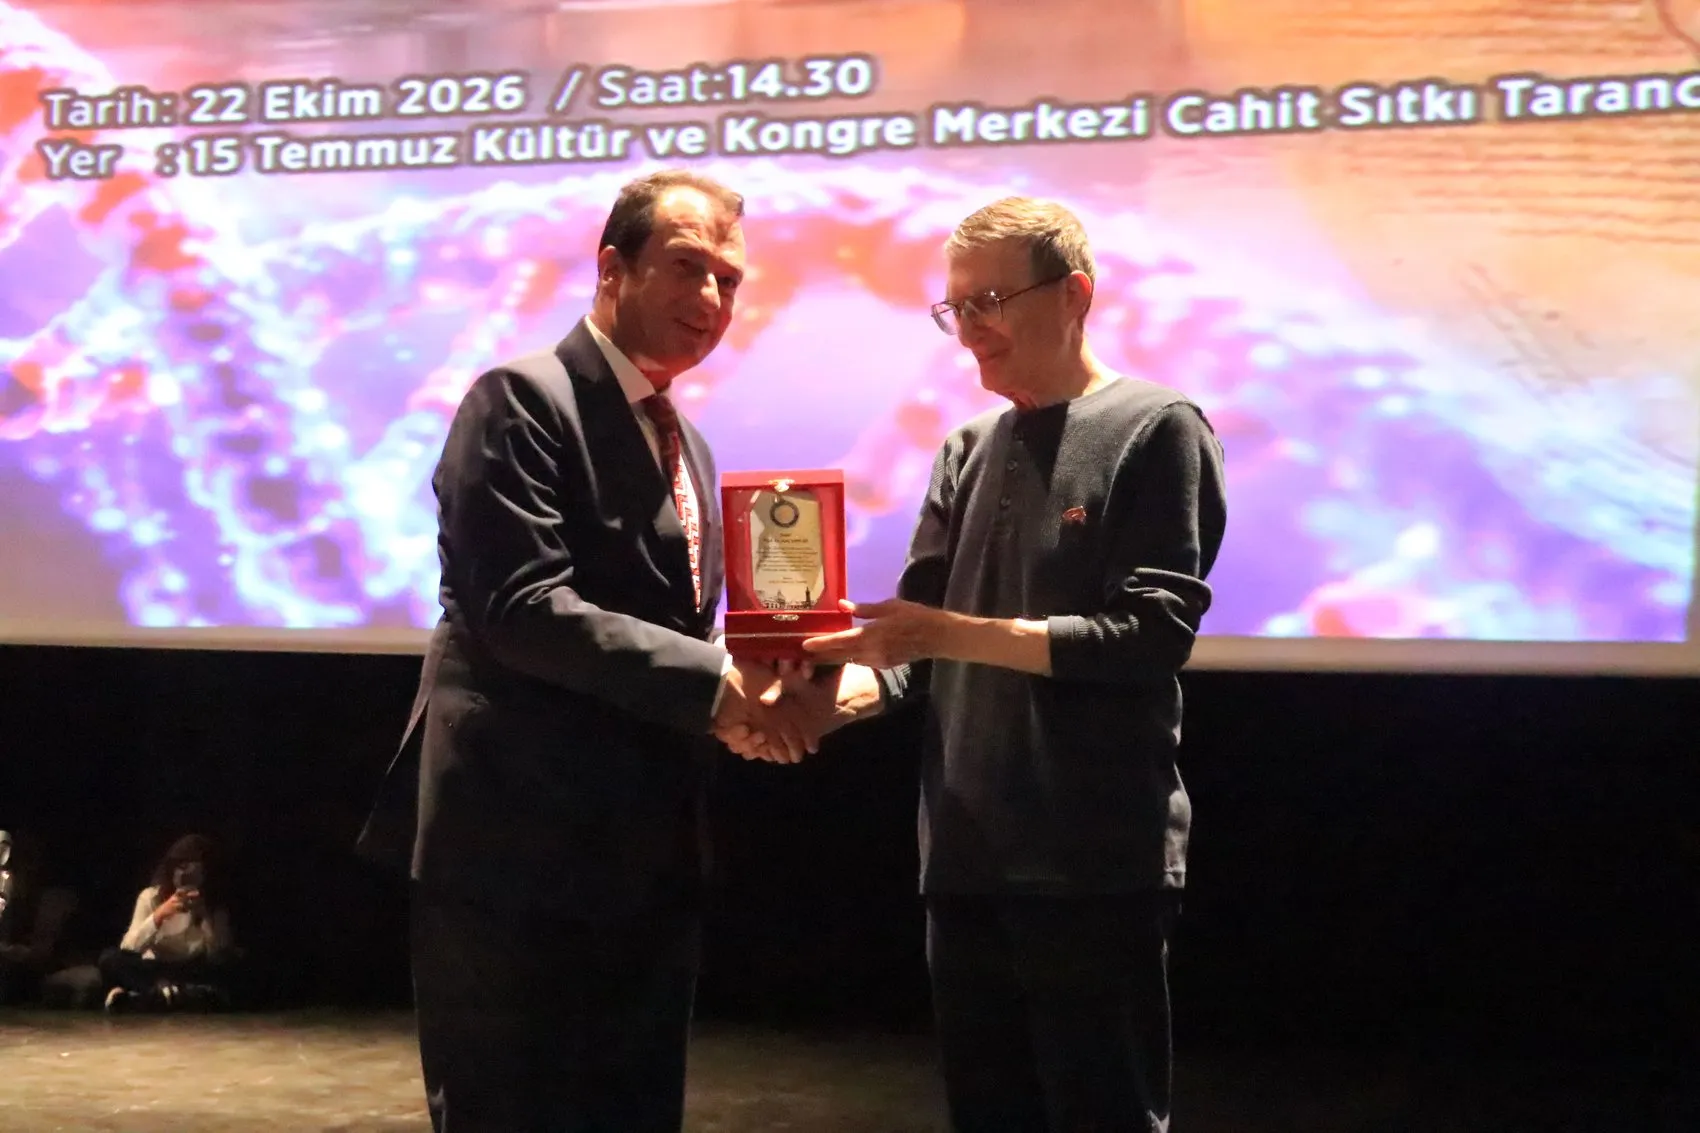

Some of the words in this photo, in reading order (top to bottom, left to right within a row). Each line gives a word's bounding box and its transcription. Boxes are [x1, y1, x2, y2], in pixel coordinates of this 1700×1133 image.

[43, 143, 117, 177] Yer
[257, 136, 456, 169] Temmuz
[475, 123, 628, 162] Kültür
[647, 126, 705, 155] ve
[725, 113, 912, 155] Kongre
[934, 100, 1147, 141] Merkezi
[1168, 90, 1320, 134] Cahit
[1340, 86, 1475, 125] Sıtkı
[44, 91, 172, 126] Tarih:
[190, 87, 247, 122] 22
[265, 83, 380, 119] Ekim
[397, 76, 523, 114] 2026
[555, 71, 581, 112] /
